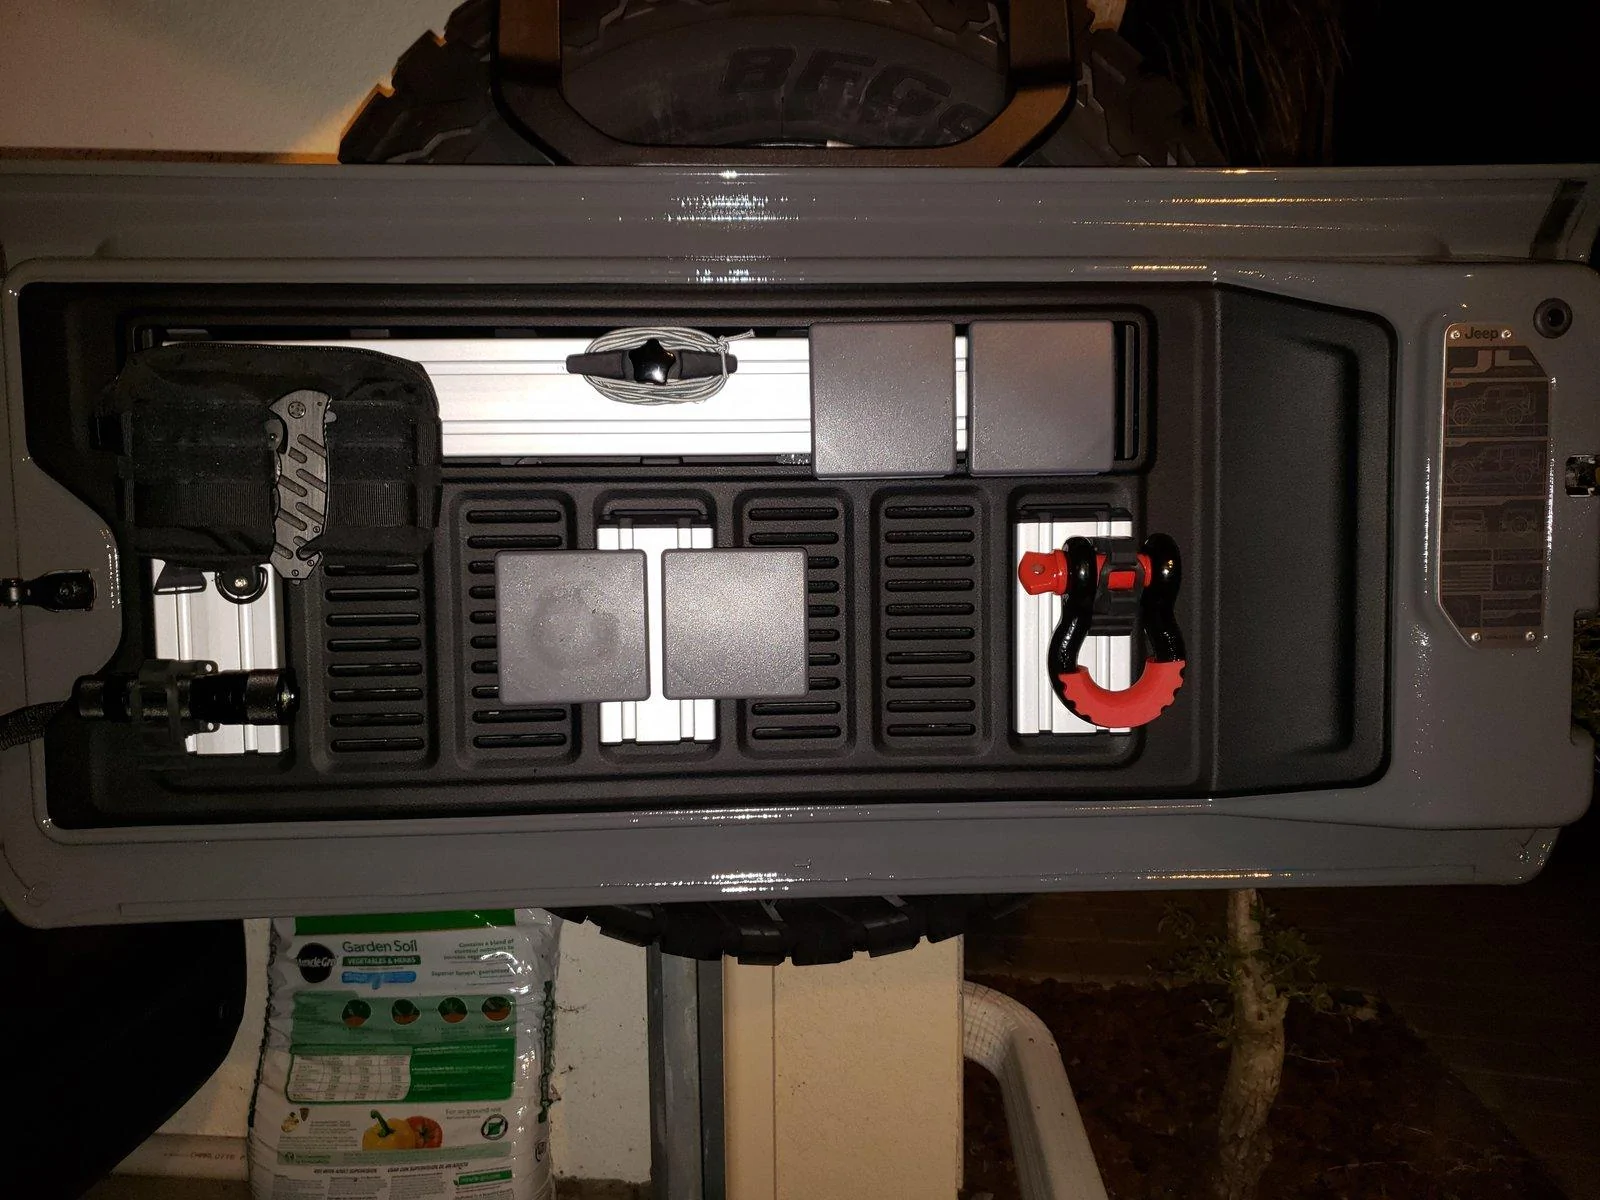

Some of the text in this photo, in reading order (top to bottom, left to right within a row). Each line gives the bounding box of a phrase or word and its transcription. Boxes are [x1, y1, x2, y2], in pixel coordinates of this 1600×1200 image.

[1464, 326, 1499, 341] Jeep
[342, 939, 418, 953] Garden Soil
